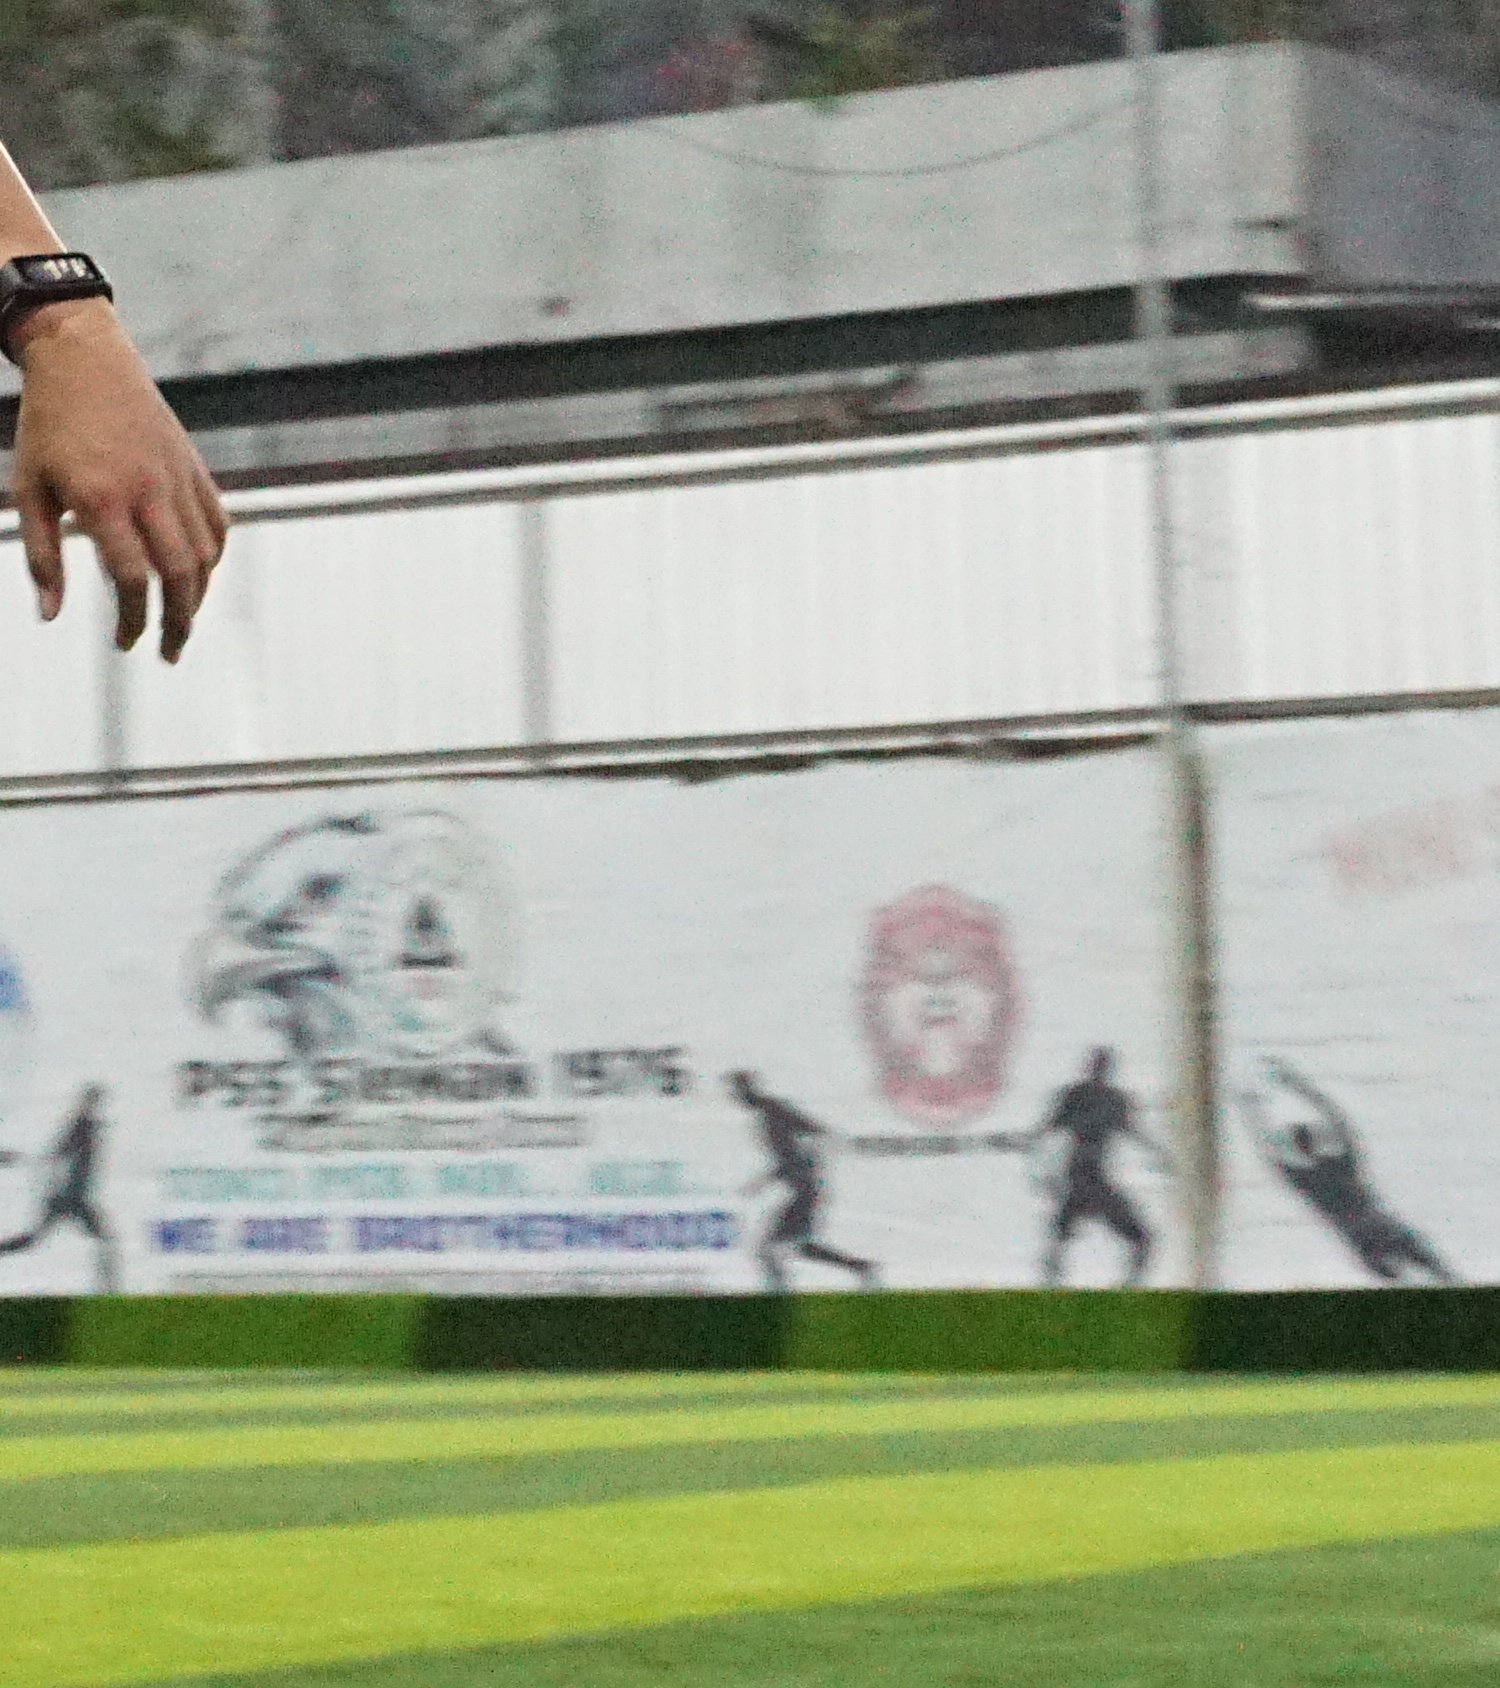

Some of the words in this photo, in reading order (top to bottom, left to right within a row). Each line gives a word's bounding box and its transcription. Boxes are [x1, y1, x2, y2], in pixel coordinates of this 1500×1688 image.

[147, 1214, 214, 1255] WE
[236, 1214, 330, 1254] ARE
[348, 1208, 738, 1254] BROTHERHOOD
